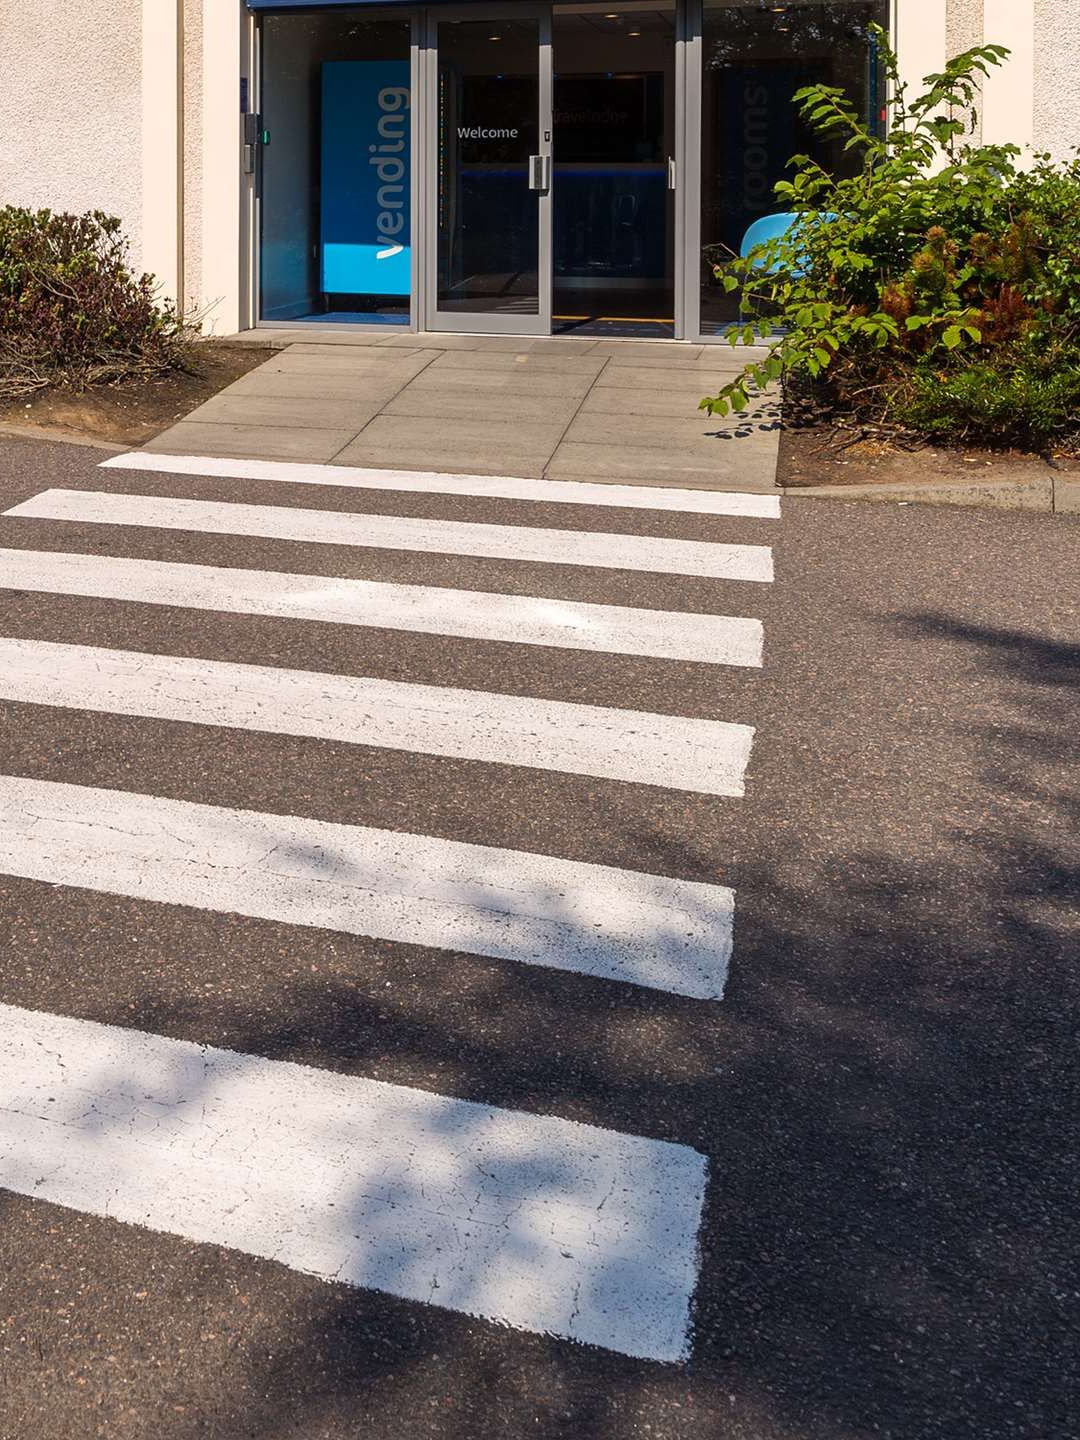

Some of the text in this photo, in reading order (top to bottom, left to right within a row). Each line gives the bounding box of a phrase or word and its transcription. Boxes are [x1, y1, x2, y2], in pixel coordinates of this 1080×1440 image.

[369, 86, 411, 260] vending
[457, 126, 519, 139] Welcome
[743, 84, 769, 210] rooms
